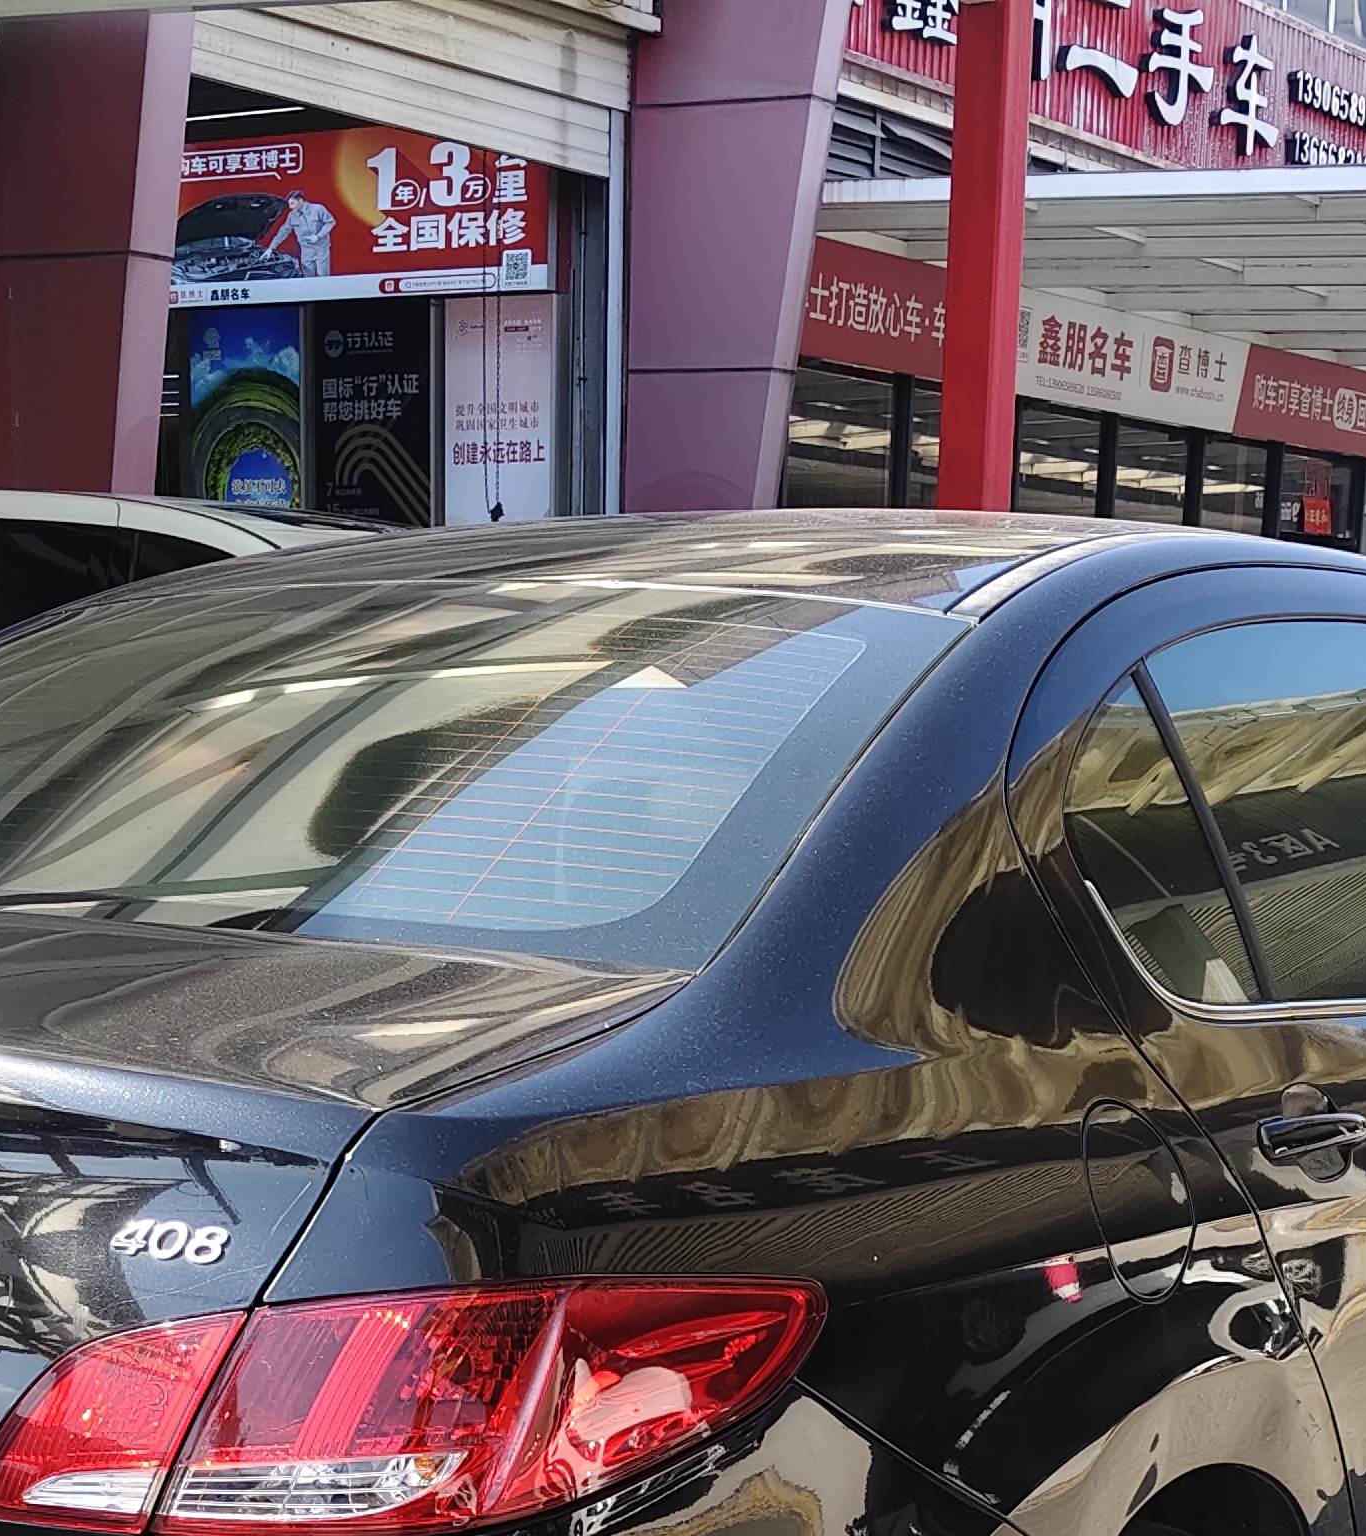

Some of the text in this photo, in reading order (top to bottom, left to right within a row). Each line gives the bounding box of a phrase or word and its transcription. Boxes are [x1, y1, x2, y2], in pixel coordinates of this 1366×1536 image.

[371, 207, 528, 254] 全国保修
[805, 271, 946, 348] 士打造放心车·车
[1037, 314, 1134, 382] 鑫朋名车
[1177, 344, 1228, 382] 查博士
[322, 398, 402, 423] 帮您挑好车
[1252, 373, 1334, 422] 购车可享查博士
[452, 438, 545, 466] 创建永远在路上
[110, 1219, 232, 1266] 408
